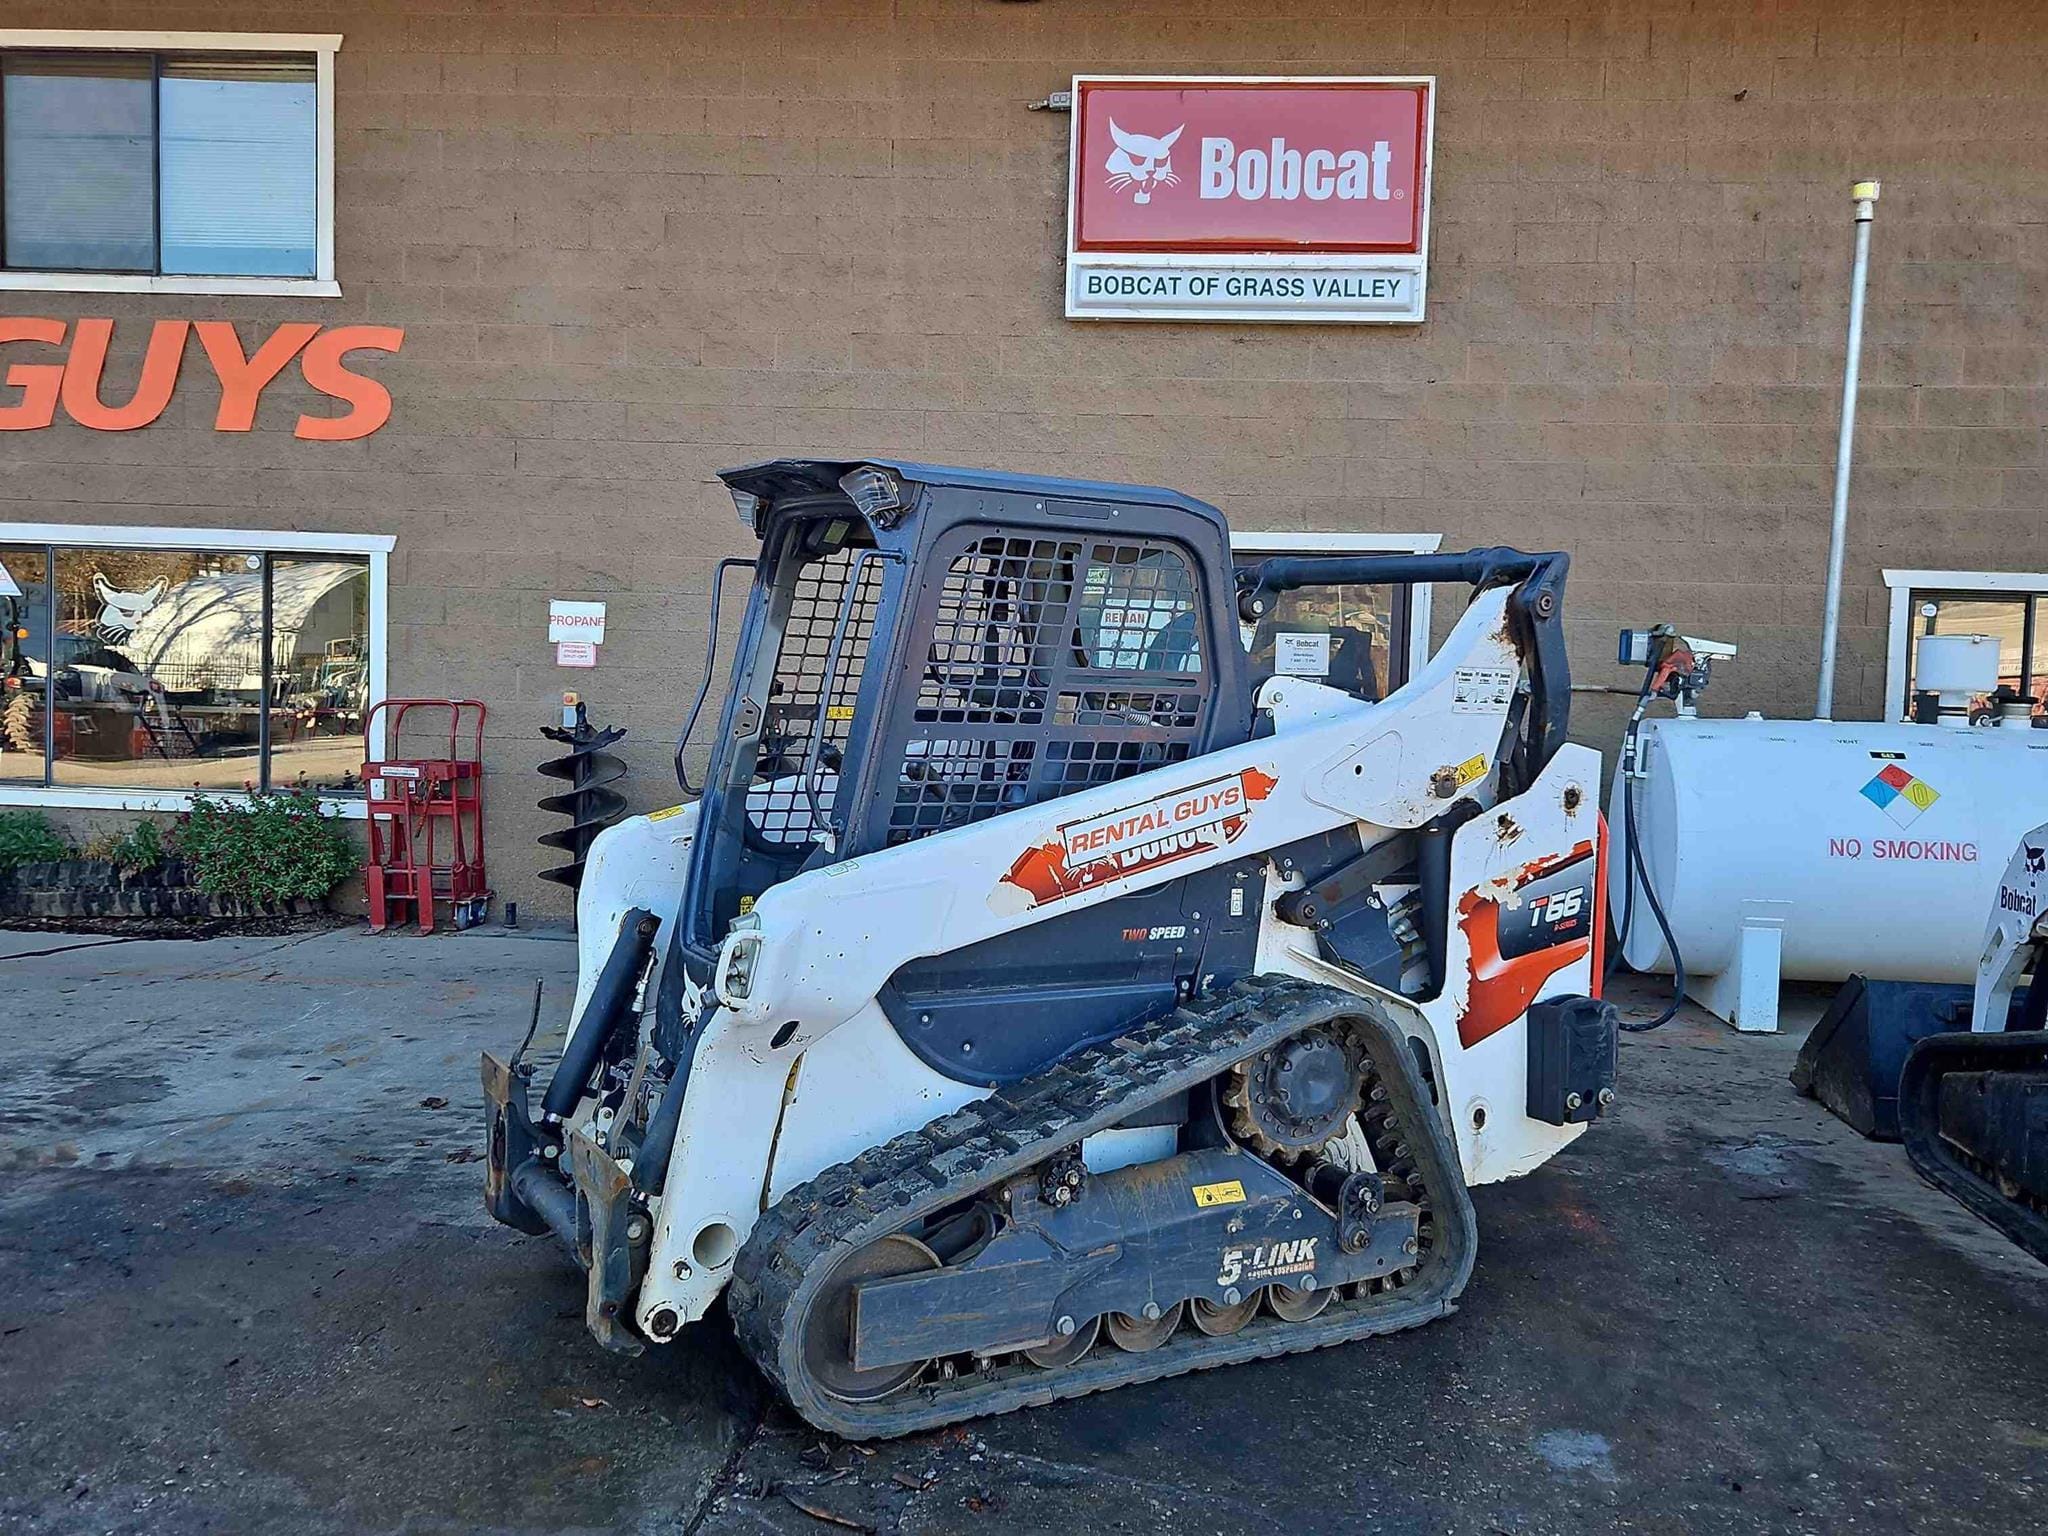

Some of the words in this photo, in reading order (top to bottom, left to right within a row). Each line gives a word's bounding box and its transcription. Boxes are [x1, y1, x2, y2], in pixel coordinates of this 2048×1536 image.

[1200, 137, 1391, 201] Bobcat
[1088, 275, 1182, 296] BOBCAT
[1189, 276, 1219, 297] OF
[1225, 277, 1305, 298] GRASS
[1312, 278, 1401, 299] VALLEY
[0, 317, 405, 441] GUYS
[549, 614, 606, 628] PROPANE
[1296, 639, 1319, 648] Bobcat
[1071, 809, 1170, 854] RENTAL
[1174, 786, 1240, 822] GUYS
[1829, 838, 1862, 857] NO
[1872, 839, 1977, 862] SMOKING
[1529, 887, 1584, 927] T66
[2000, 885, 2036, 917] Bobcat
[1122, 928, 1148, 940] TWO
[1149, 926, 1186, 940] SPEED
[1217, 1237, 1319, 1286] 5-LINK
